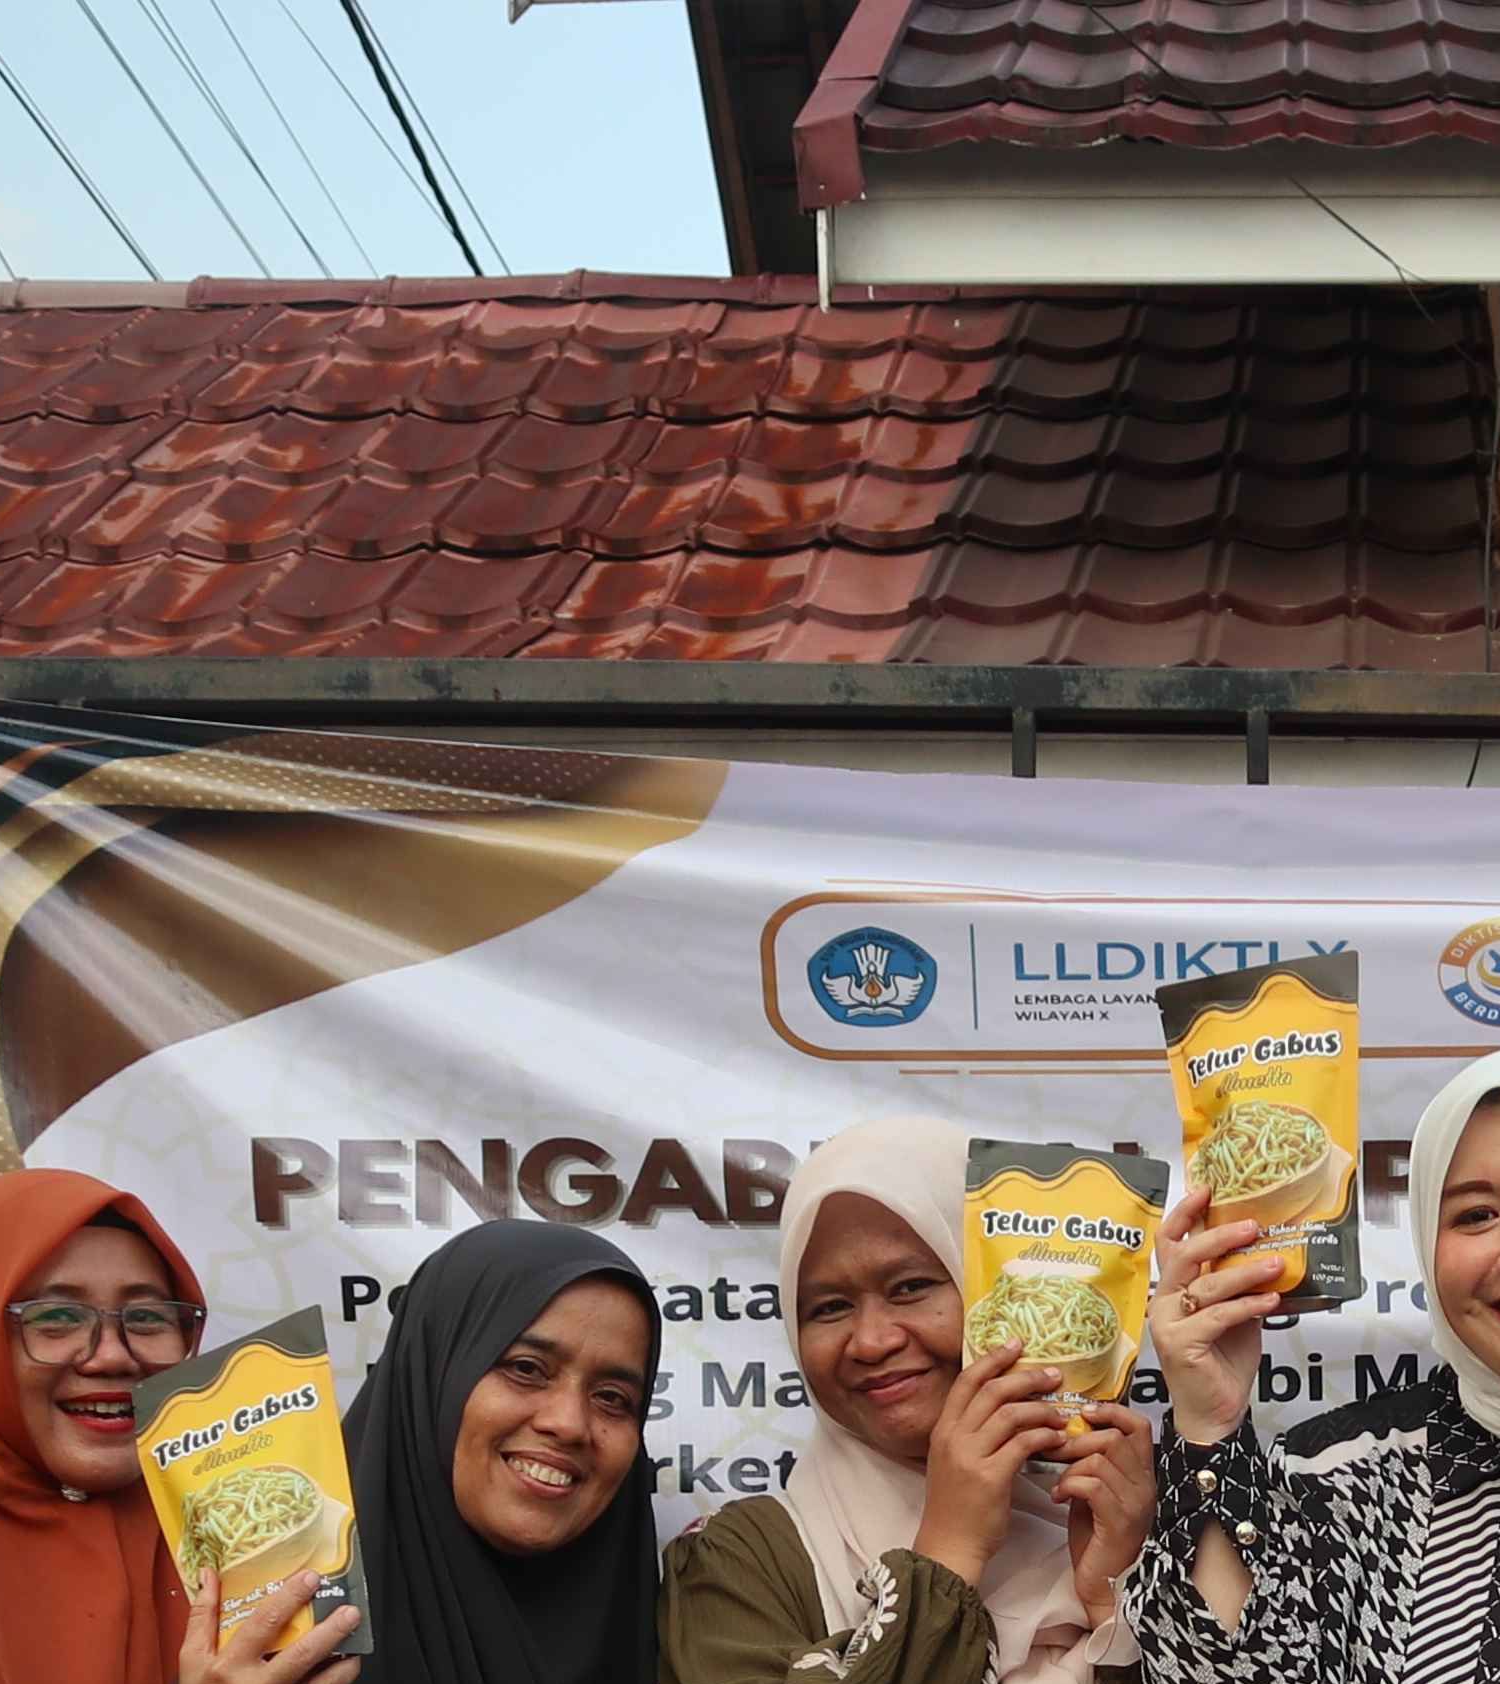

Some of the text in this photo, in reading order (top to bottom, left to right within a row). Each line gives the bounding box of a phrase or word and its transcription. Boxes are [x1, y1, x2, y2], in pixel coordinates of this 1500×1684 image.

[1014, 993, 1160, 1006] LEMBAGA LAYAN
[1014, 1010, 1110, 1022] WILAYAH X
[1185, 1030, 1342, 1087] Telur Gabus
[982, 1210, 1145, 1250] Telur Gabus
[152, 1384, 318, 1470] Telur Gabus
